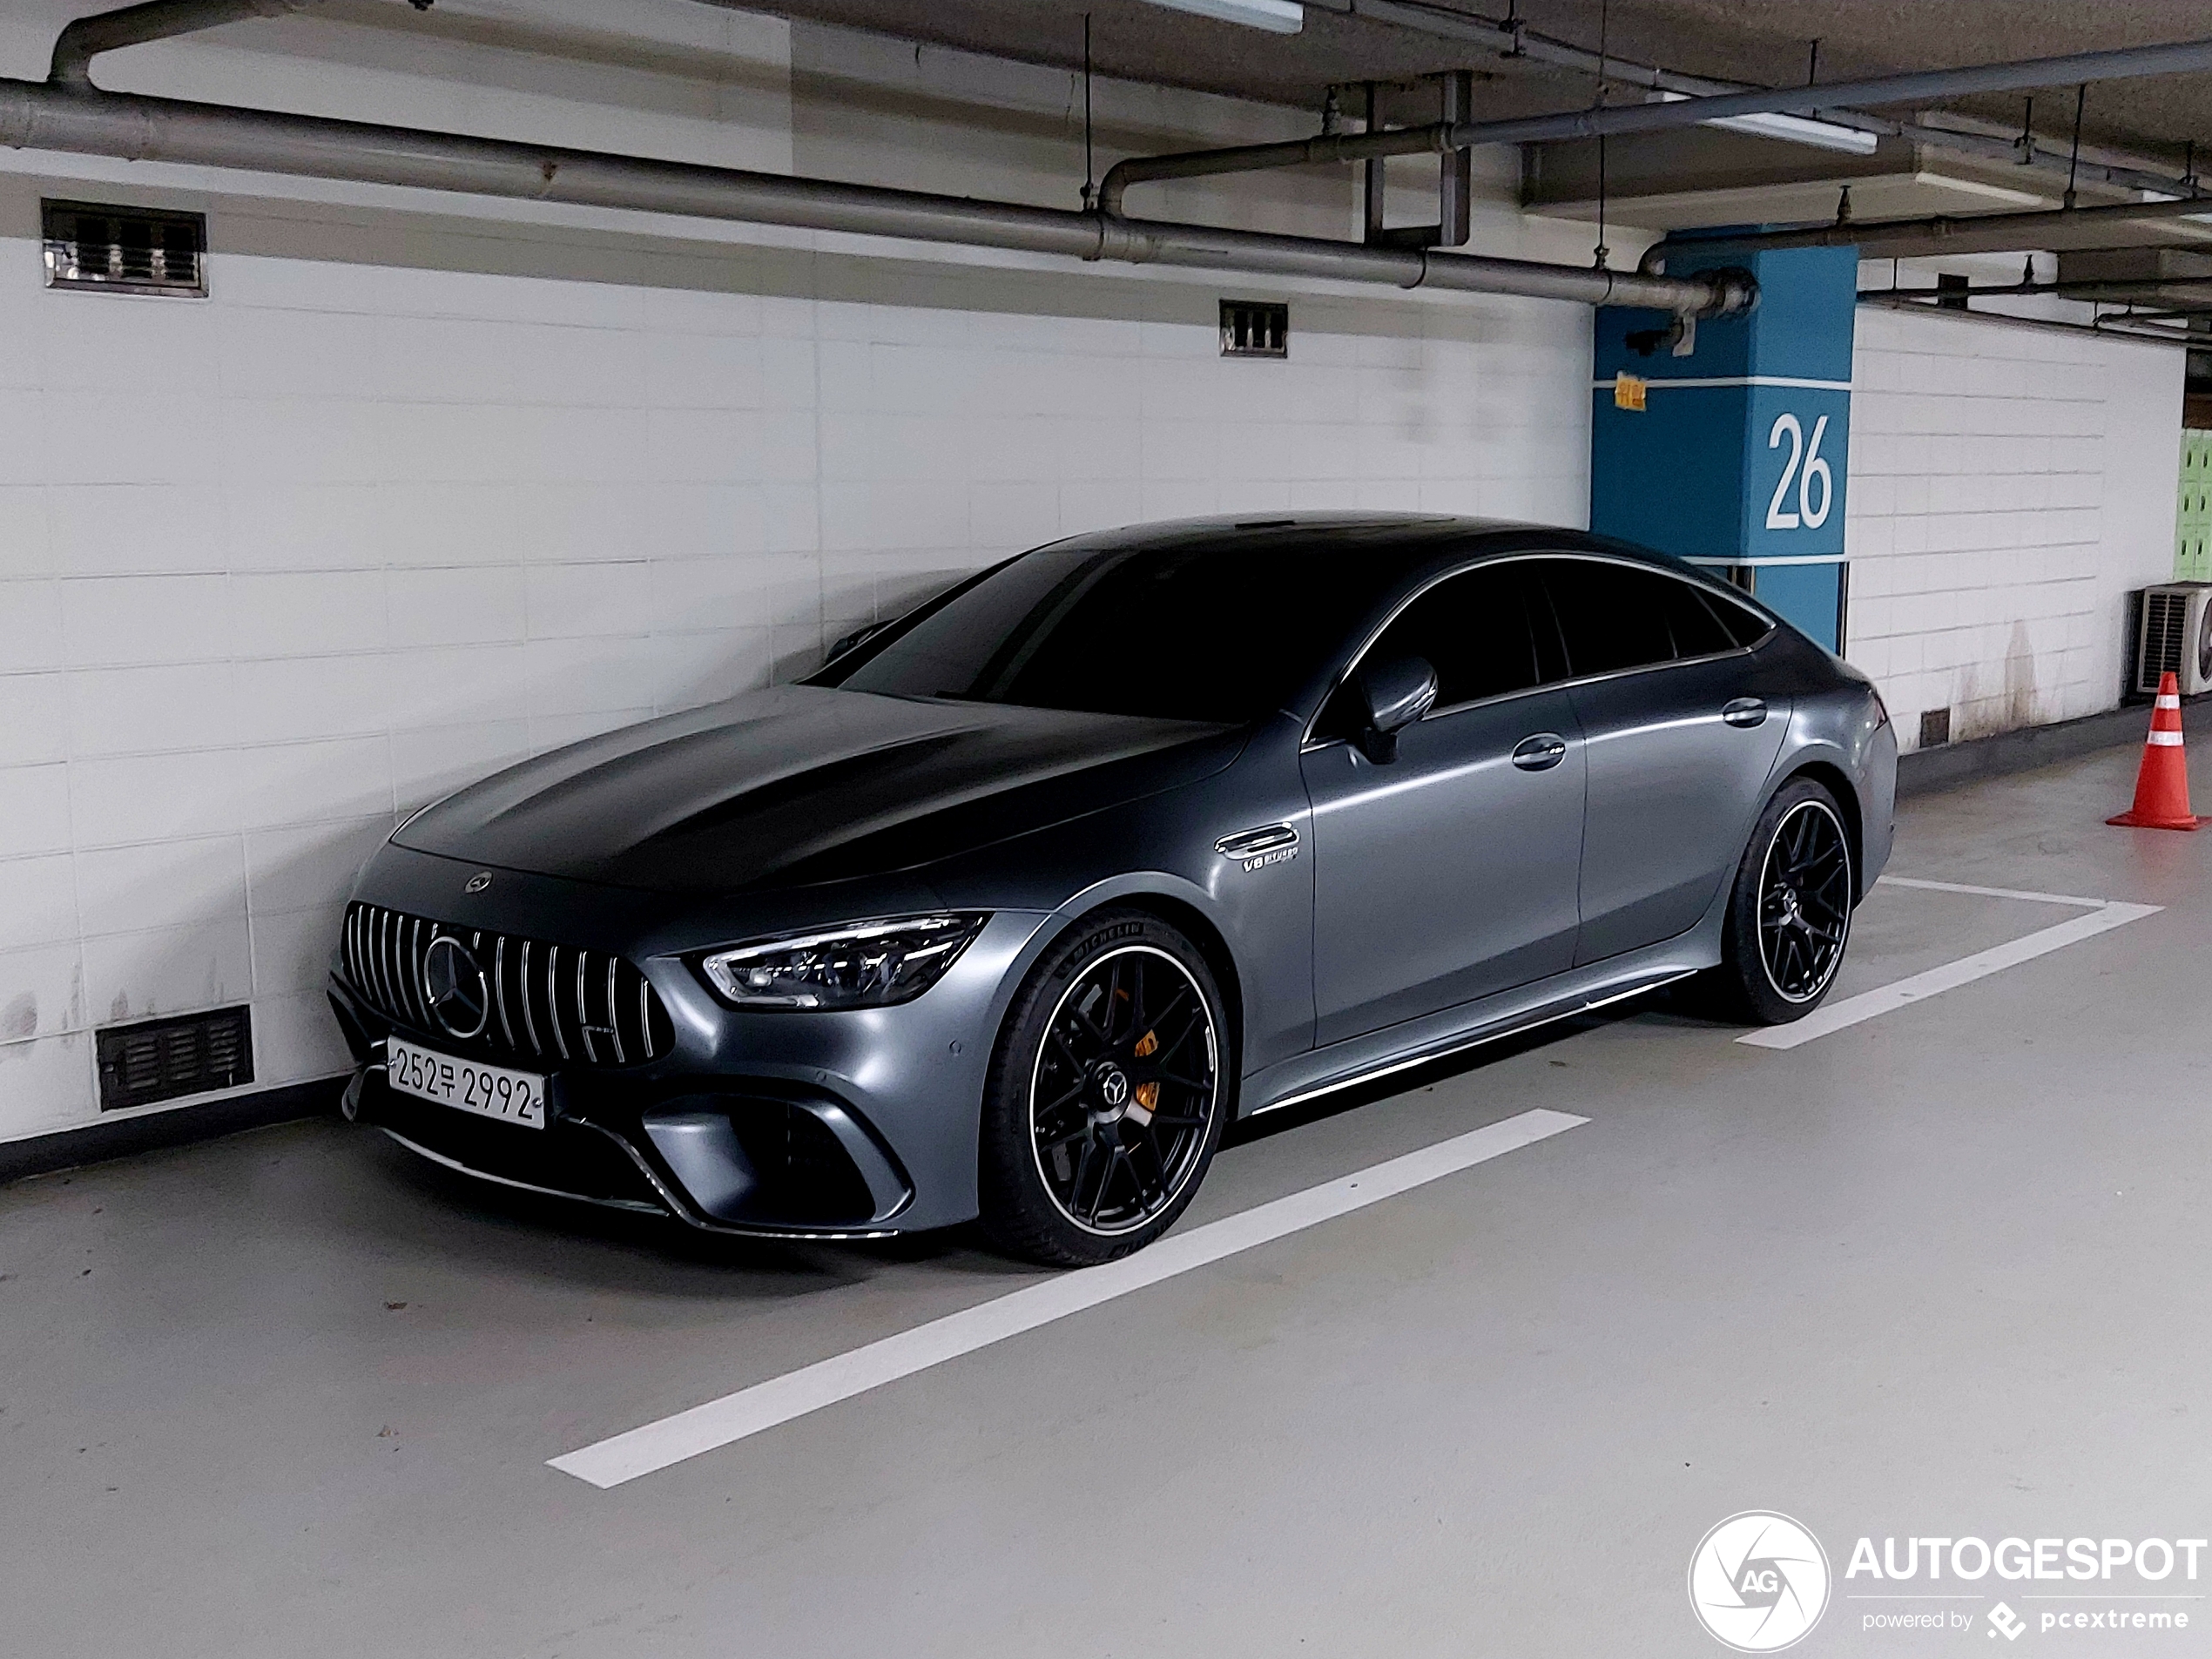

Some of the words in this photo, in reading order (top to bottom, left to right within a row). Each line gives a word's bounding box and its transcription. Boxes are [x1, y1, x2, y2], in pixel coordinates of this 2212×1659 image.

[1765, 413, 1832, 529] 26
[1244, 857, 1263, 872] V8
[1072, 922, 1143, 964] MICHELIN
